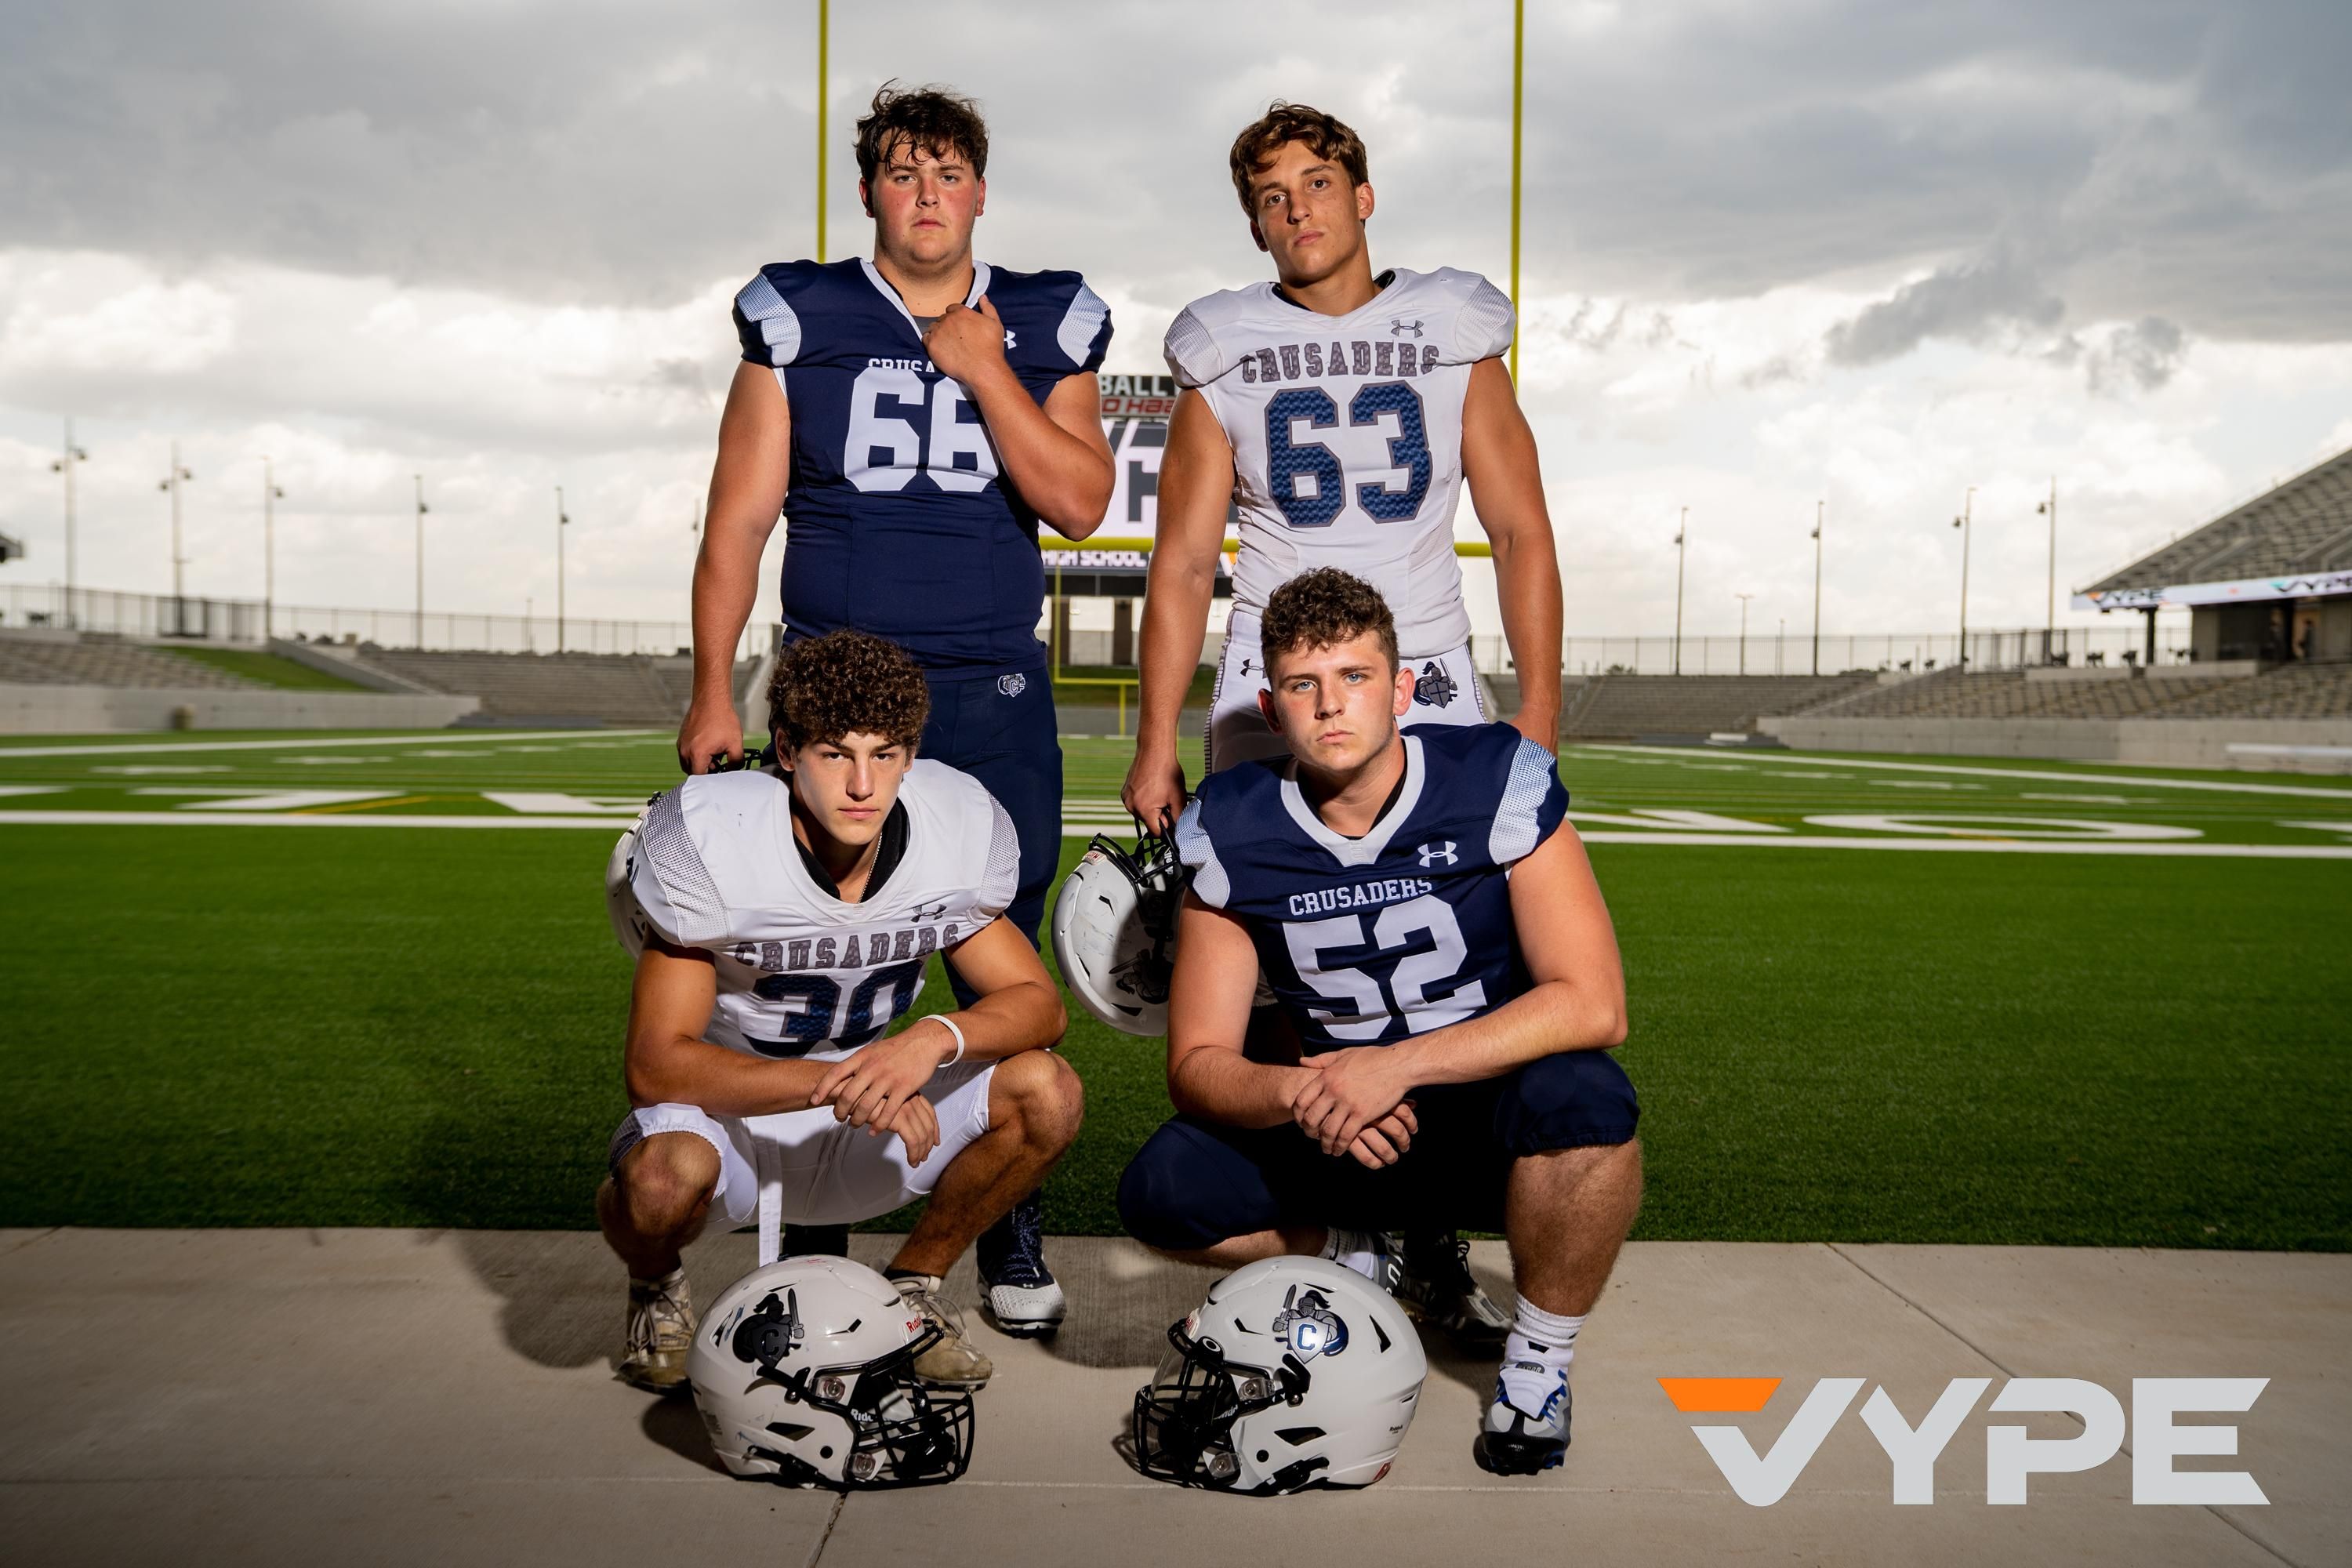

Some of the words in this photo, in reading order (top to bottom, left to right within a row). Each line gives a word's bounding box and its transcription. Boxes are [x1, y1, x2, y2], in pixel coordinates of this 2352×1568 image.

[1240, 340, 1439, 383] CRUSADERS
[1099, 376, 1168, 397] BALL
[844, 366, 999, 493] 66
[1264, 379, 1434, 528] 63
[1041, 550, 1078, 567] HIGH
[1080, 550, 1146, 568] SCHOOL
[1289, 877, 1433, 916] CRUSADERS
[735, 924, 960, 972] CRUSADERS
[1282, 895, 1488, 1040] 52
[742, 959, 925, 1059] 30
[1296, 1322, 1318, 1352] C
